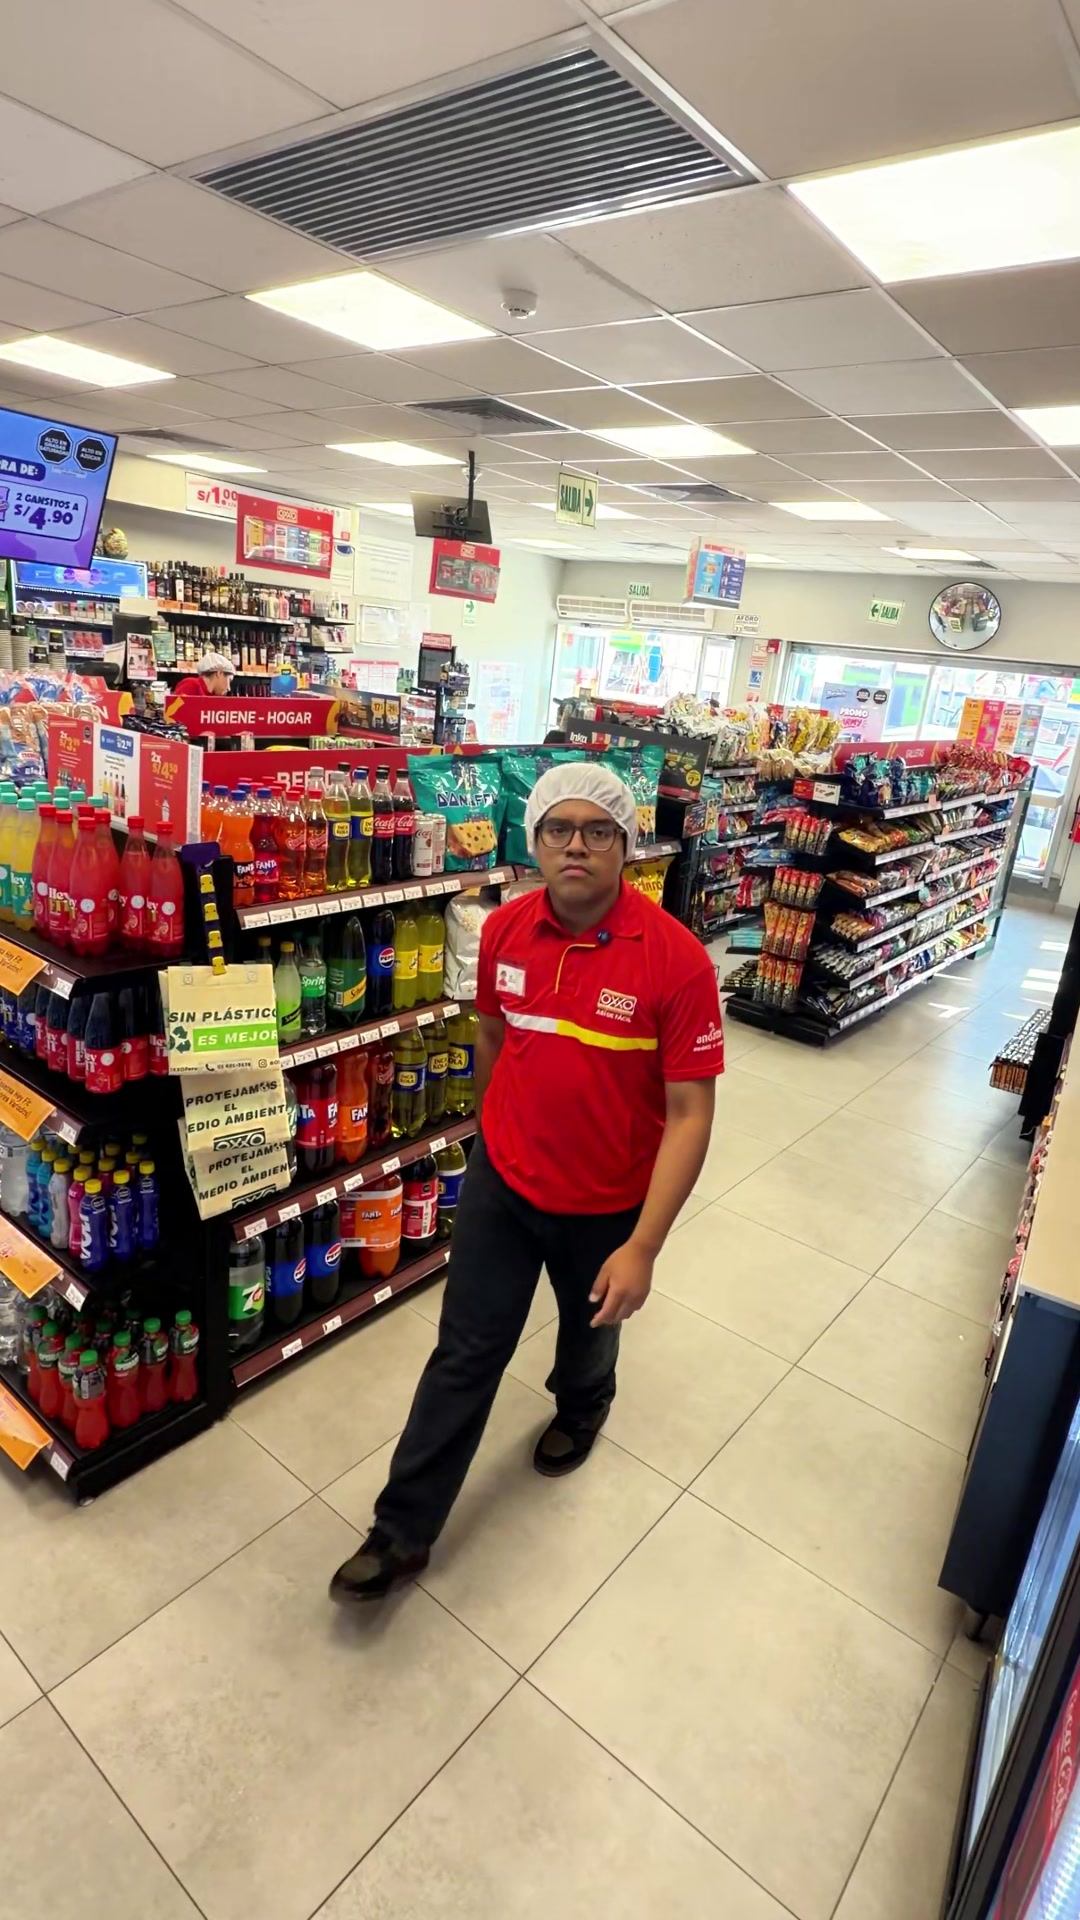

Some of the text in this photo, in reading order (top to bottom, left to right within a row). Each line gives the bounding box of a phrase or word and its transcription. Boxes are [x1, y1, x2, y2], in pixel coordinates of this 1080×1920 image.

[0, 459, 39, 477] RA DE:
[16, 493, 79, 511] 2 GANSITOS A
[560, 484, 581, 513] SALIDA
[14, 504, 73, 530] S/4.90
[628, 584, 649, 597] SALIDA
[880, 605, 899, 620] SALIDA
[200, 710, 256, 724] HIGIENE
[267, 711, 312, 724] HOGAR
[840, 707, 869, 718] PROMO
[569, 732, 588, 744] Inka
[601, 993, 633, 1011] OXXO
[169, 1012, 196, 1023] SIN
[197, 1030, 278, 1046] ES MEJOR
[449, 1058, 463, 1066] OLA
[224, 1103, 238, 1112] EL
[351, 1103, 368, 1121] FAN
[188, 1118, 220, 1133] EDIO
[225, 1104, 288, 1126] AMBIENT
[214, 1131, 265, 1151] OXXO
[241, 1165, 254, 1175] EL
[199, 1180, 239, 1200] MEDIO
[242, 1162, 288, 1186] AMBIEN
